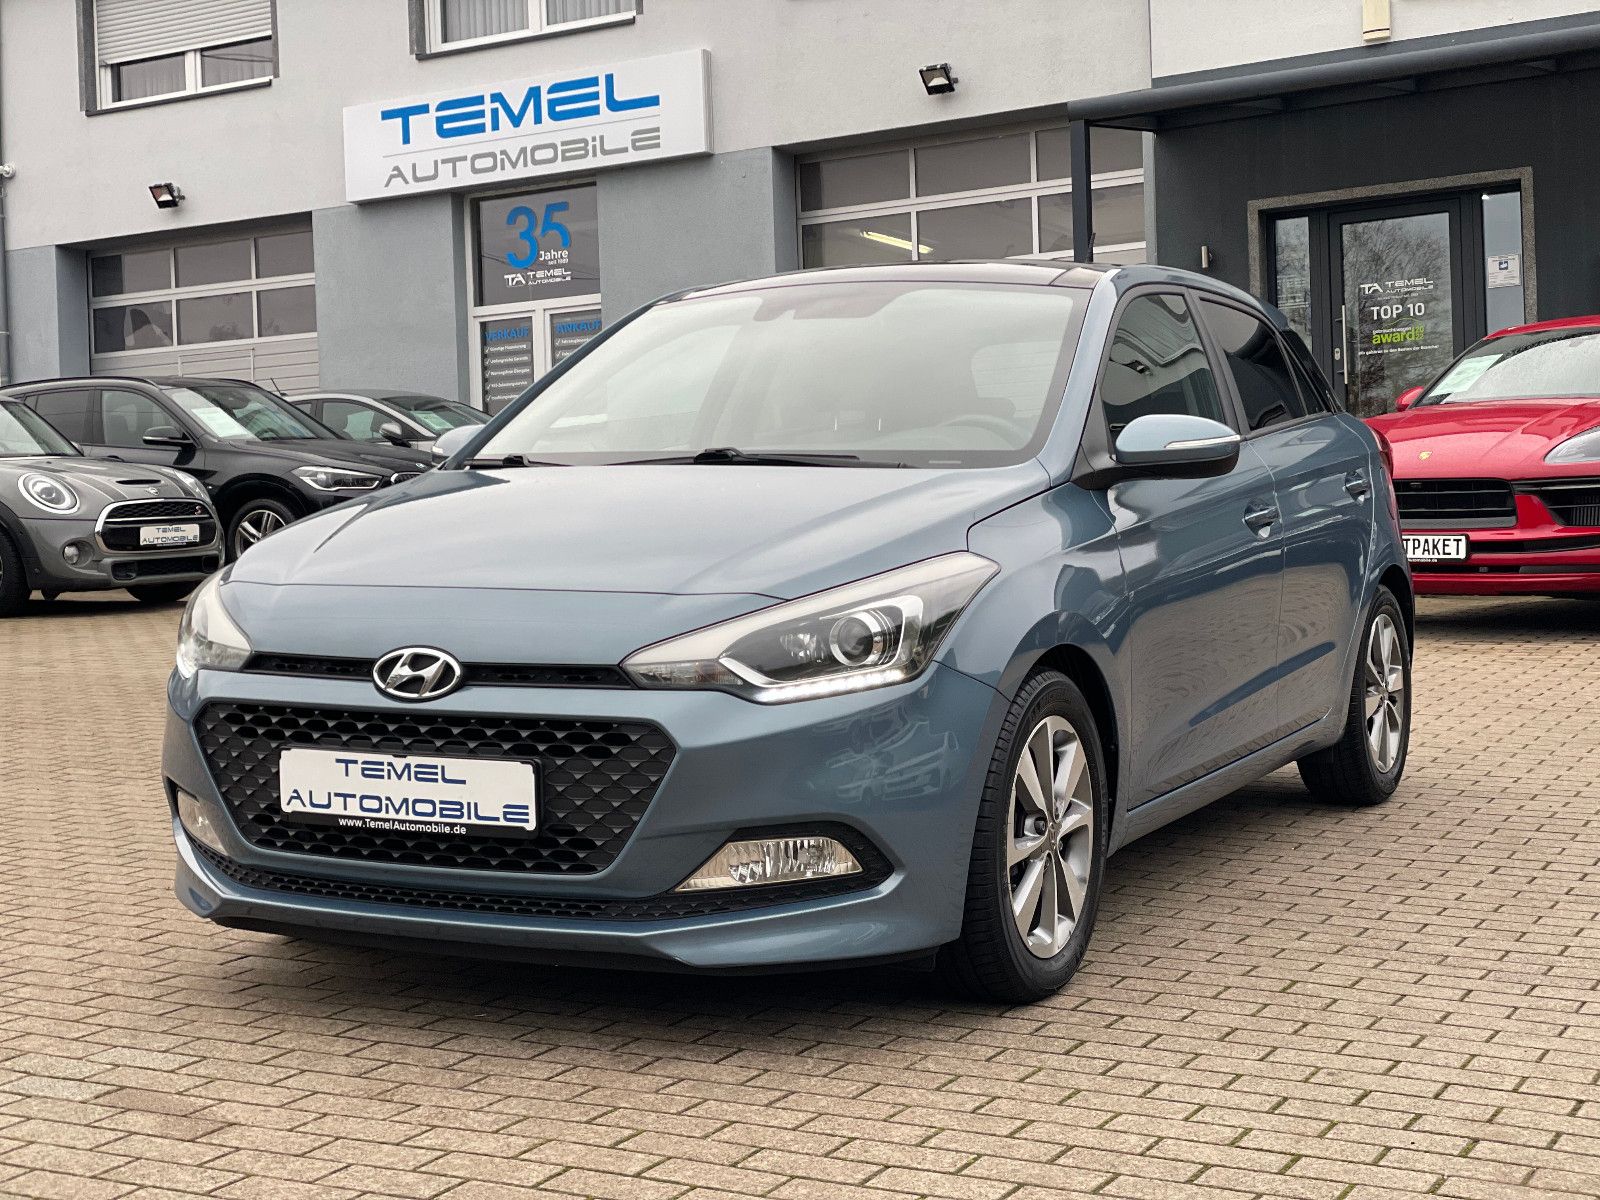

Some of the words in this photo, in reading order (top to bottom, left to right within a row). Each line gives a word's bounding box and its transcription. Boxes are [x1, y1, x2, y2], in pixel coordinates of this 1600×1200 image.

[381, 73, 660, 145] TEMEL
[505, 201, 572, 269] 35
[539, 249, 569, 261] Jahre
[527, 268, 572, 279] TEMEL
[1385, 277, 1433, 288] TEMEL
[1370, 304, 1403, 320] TOP
[1407, 302, 1425, 317] 10
[486, 326, 529, 342] VERKAUF
[556, 319, 602, 334] ANKAUF
[1372, 326, 1415, 345] award
[142, 534, 198, 544] AUTOMOBILE
[1402, 538, 1463, 556] TPAKET
[335, 758, 467, 785] TEMEL
[286, 788, 530, 824] AUTOMOBILE
[338, 817, 467, 835] www.TemelAutomobile.de
